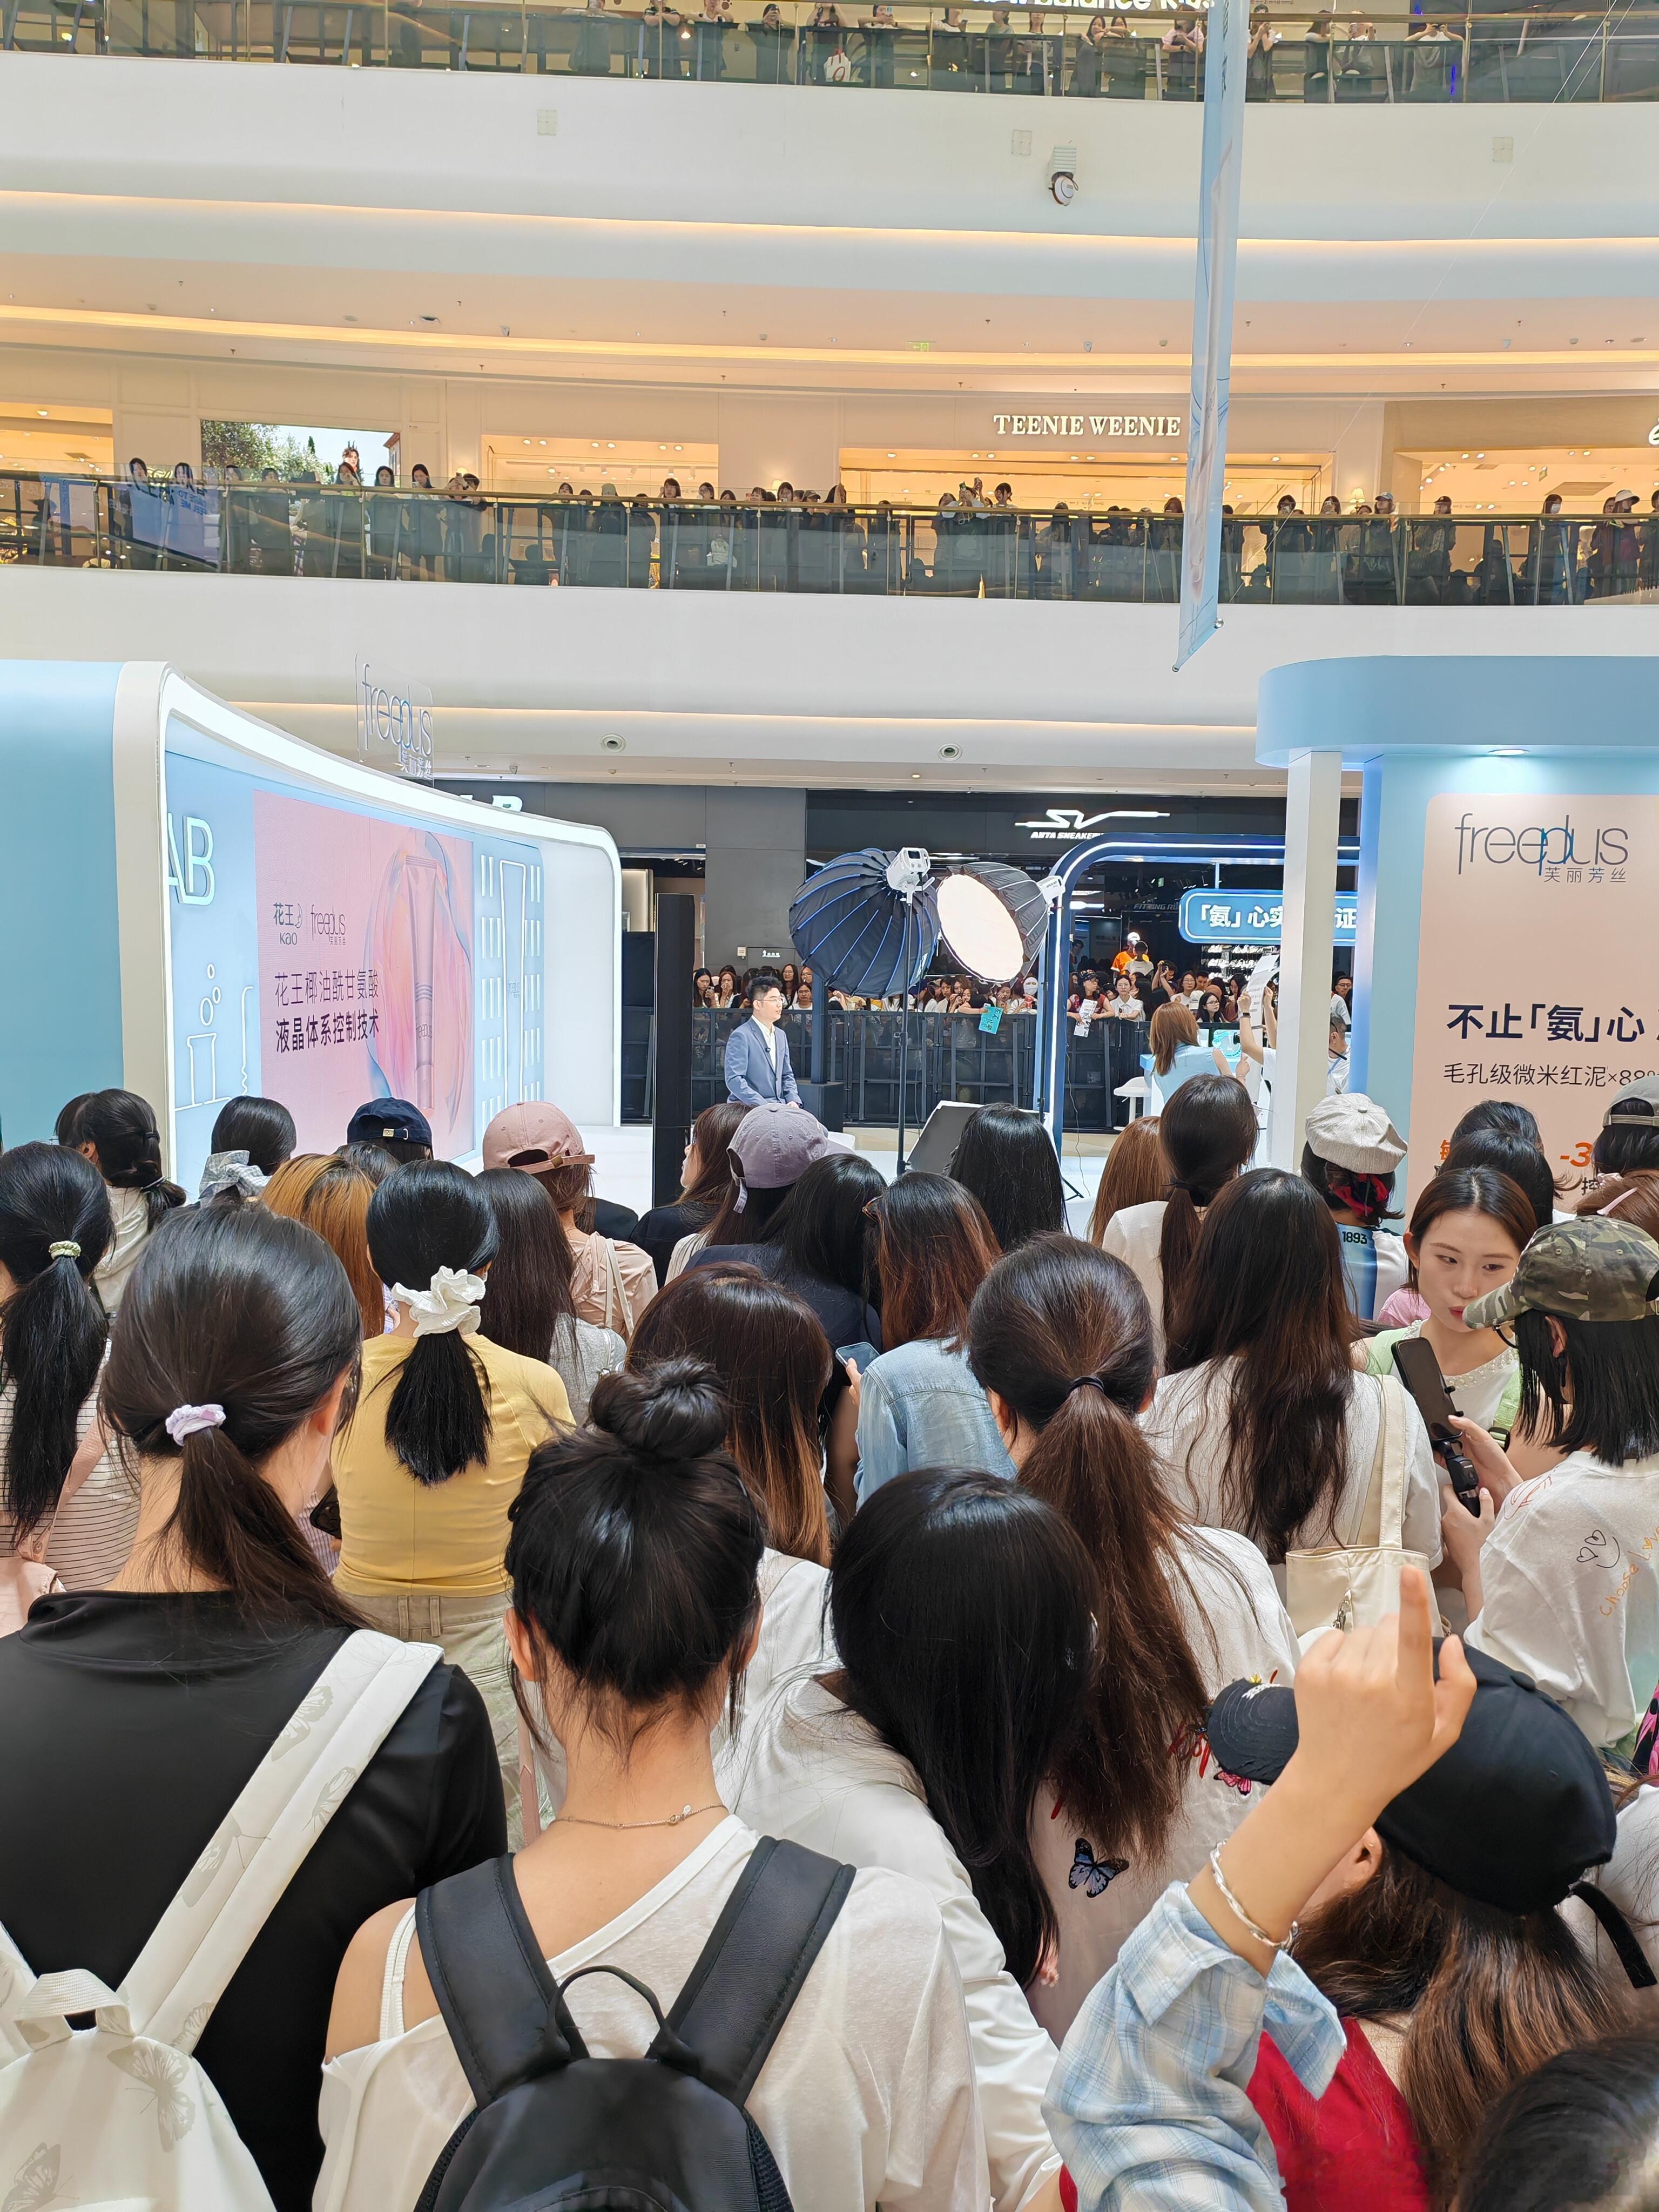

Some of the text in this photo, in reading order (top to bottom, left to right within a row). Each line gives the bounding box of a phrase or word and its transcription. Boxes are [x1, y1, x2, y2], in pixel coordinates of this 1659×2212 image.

[993, 415, 1182, 436] TEENIE WEENIE
[1543, 867, 1627, 884] 芙丽芳丝
[273, 902, 294, 925] 花王
[274, 969, 379, 1007] 花王椰油酰甘氨酸
[276, 1008, 379, 1053] 液晶体系控制技术
[1447, 1003, 1659, 1042] 不止「氨」心
[1342, 1231, 1367, 1244] 1893
